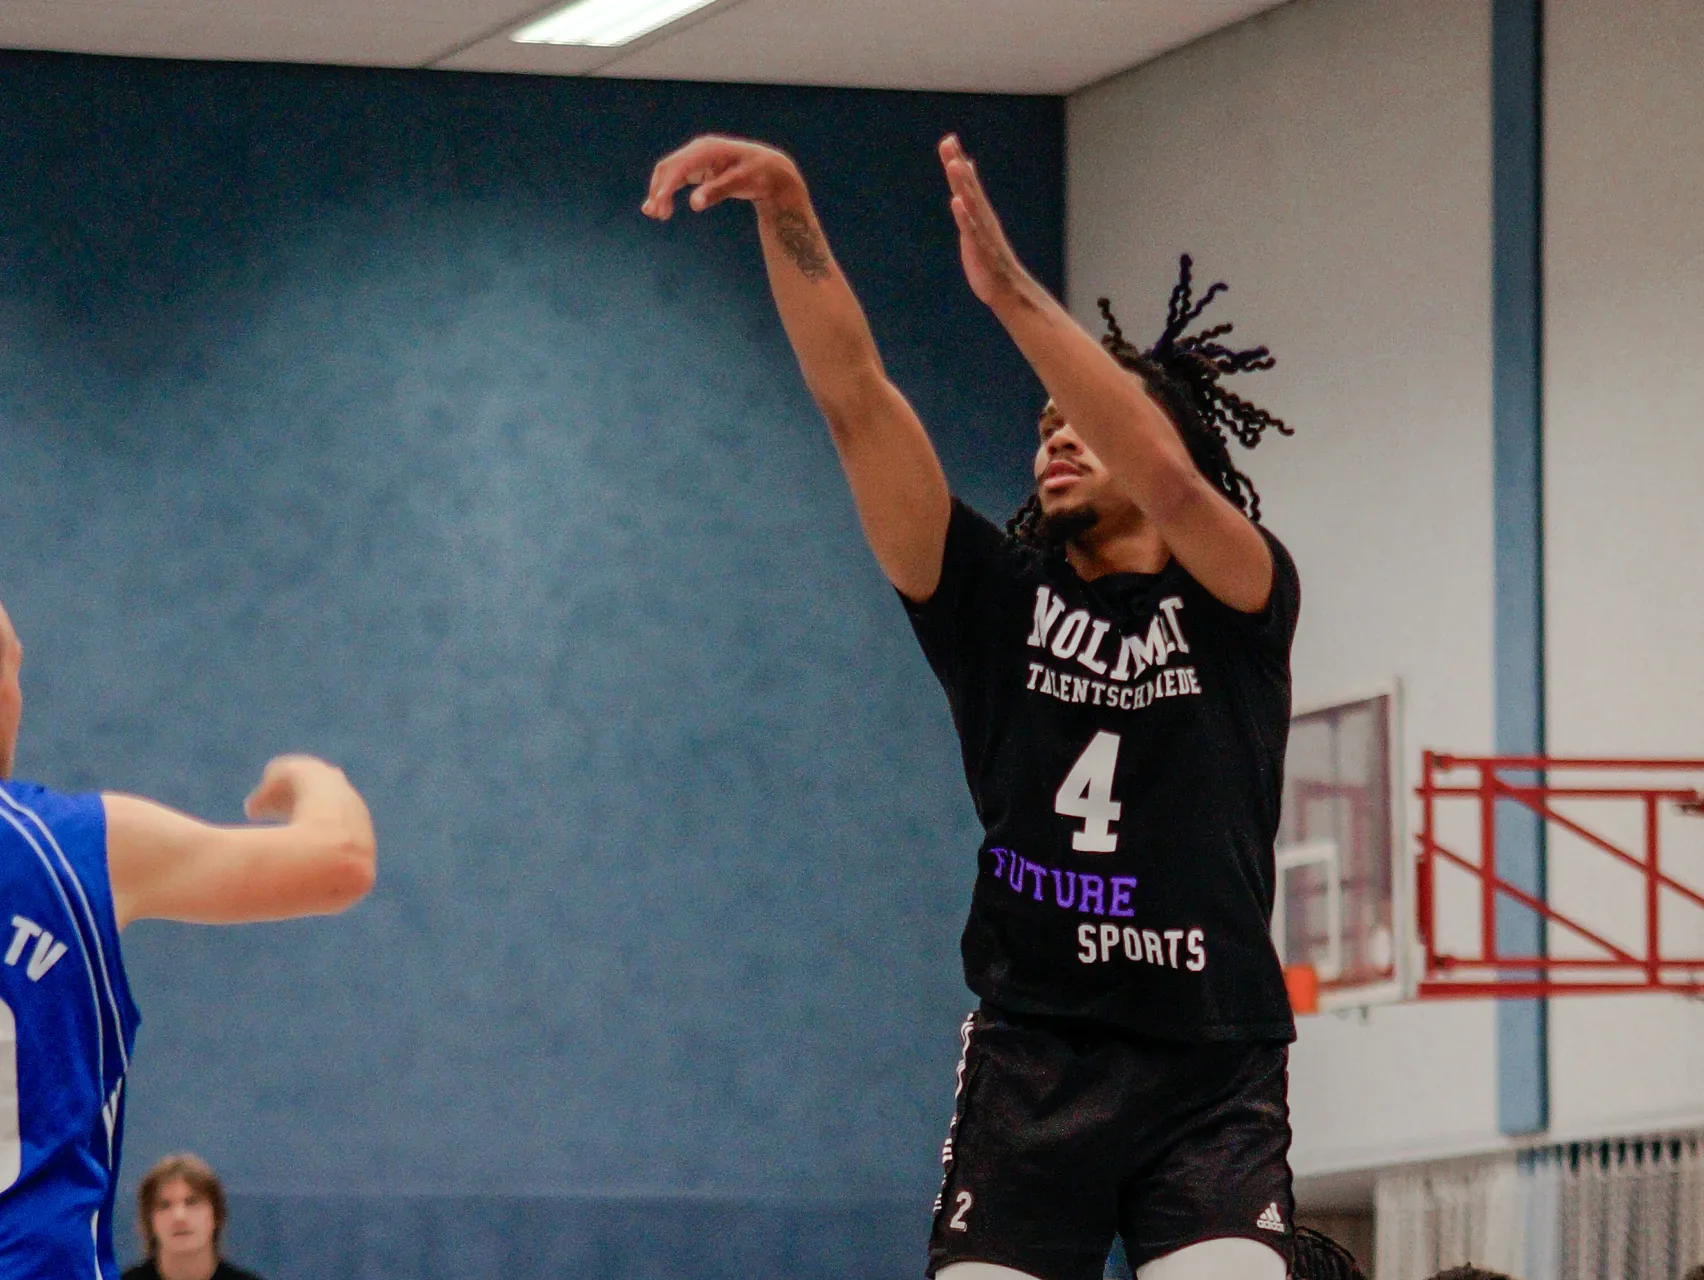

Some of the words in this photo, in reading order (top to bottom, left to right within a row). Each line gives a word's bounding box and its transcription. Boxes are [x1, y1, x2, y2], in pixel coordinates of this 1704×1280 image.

[1055, 731, 1122, 852] 4
[989, 847, 1138, 917] FUTURE
[4, 915, 68, 983] TV
[1077, 924, 1206, 972] SPORTS
[950, 1191, 973, 1232] 2
